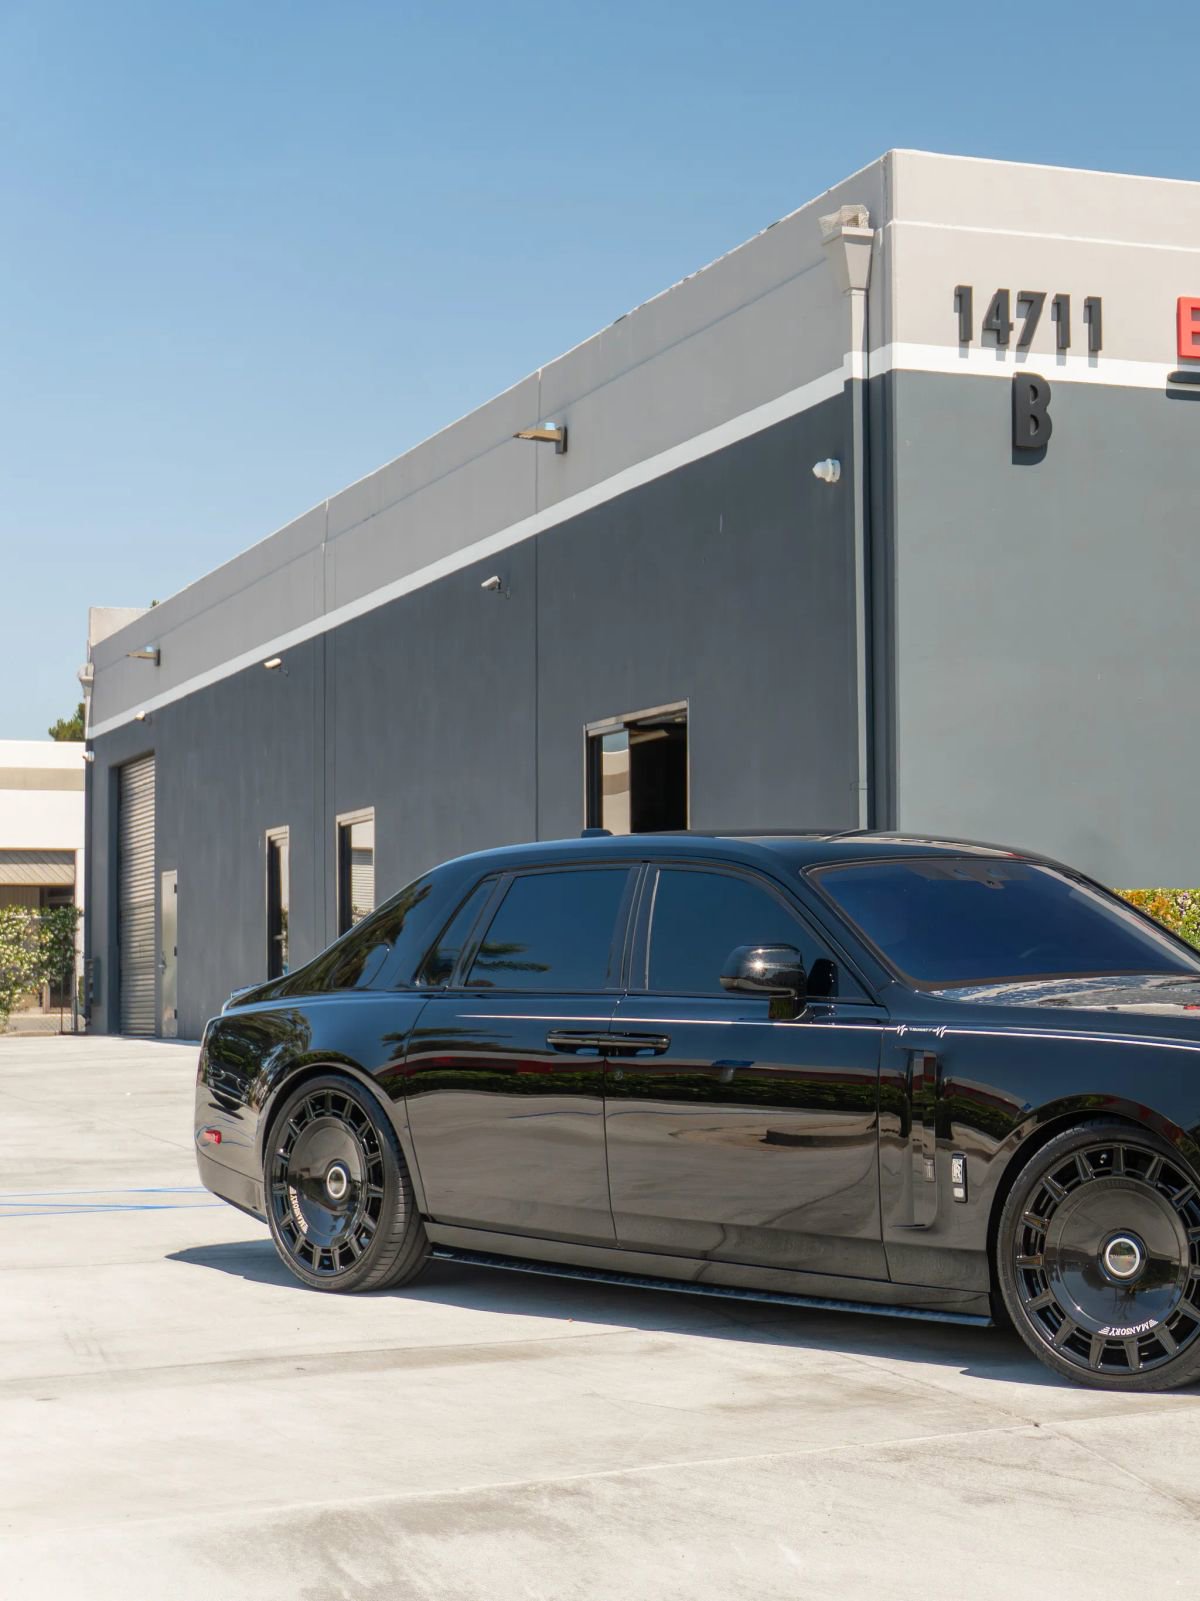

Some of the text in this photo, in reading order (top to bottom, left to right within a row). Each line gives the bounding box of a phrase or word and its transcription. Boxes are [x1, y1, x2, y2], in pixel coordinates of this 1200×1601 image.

[954, 284, 1103, 352] 14711
[1012, 371, 1053, 449] B
[1108, 1322, 1150, 1337] MANSORY
